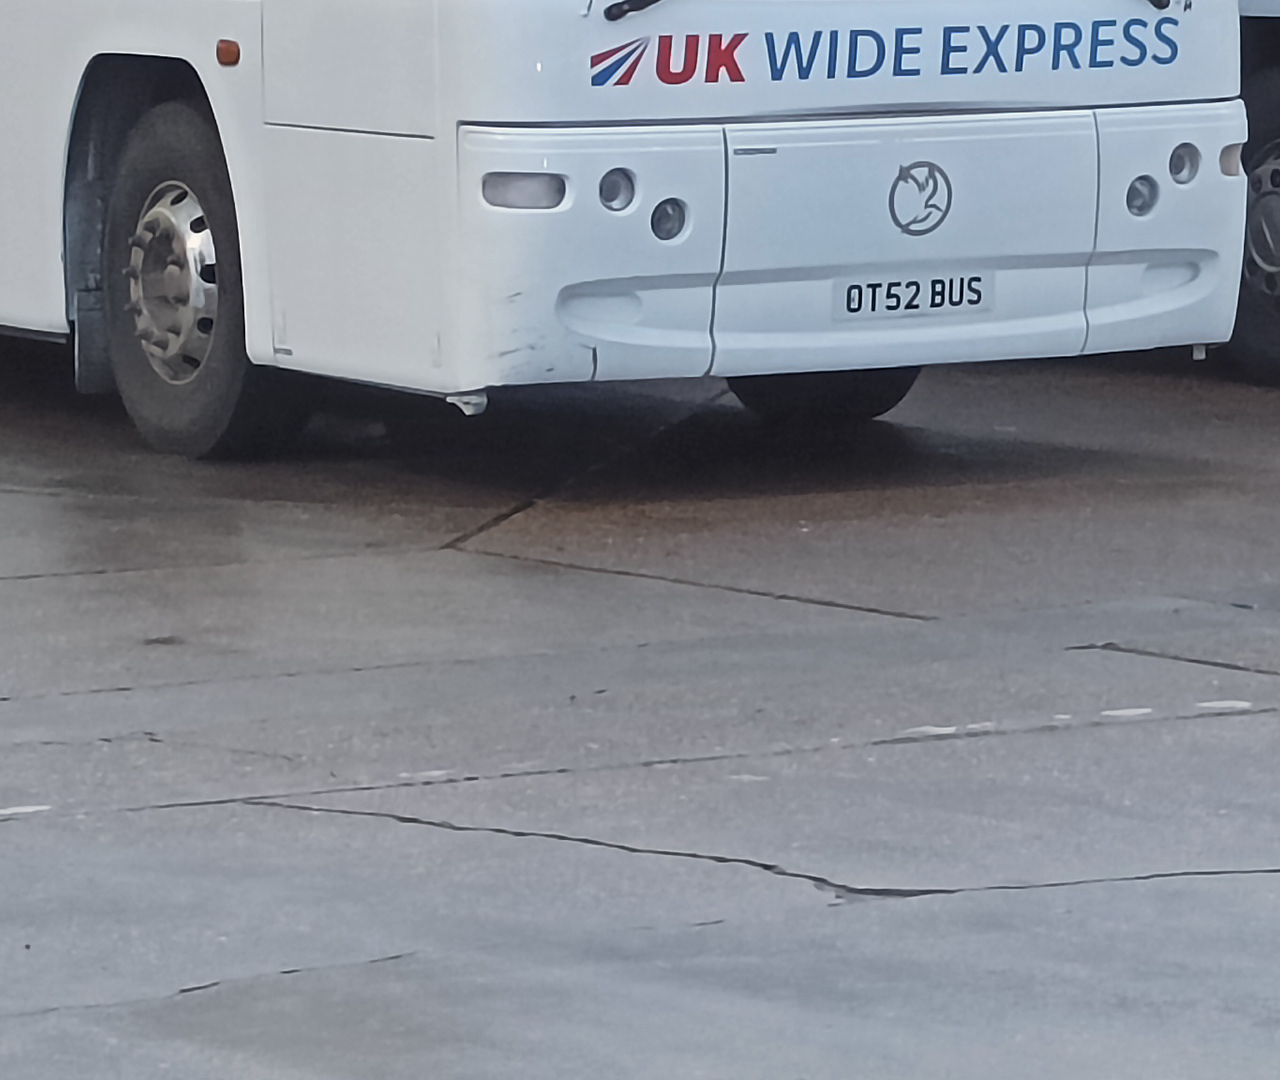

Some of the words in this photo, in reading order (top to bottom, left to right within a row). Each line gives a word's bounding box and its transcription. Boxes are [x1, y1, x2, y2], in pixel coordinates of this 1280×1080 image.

[655, 32, 749, 85] UK
[764, 27, 923, 81] WIDE
[939, 16, 1181, 76] EXPRESS
[846, 280, 920, 313] OT52
[929, 276, 982, 308] BUS
